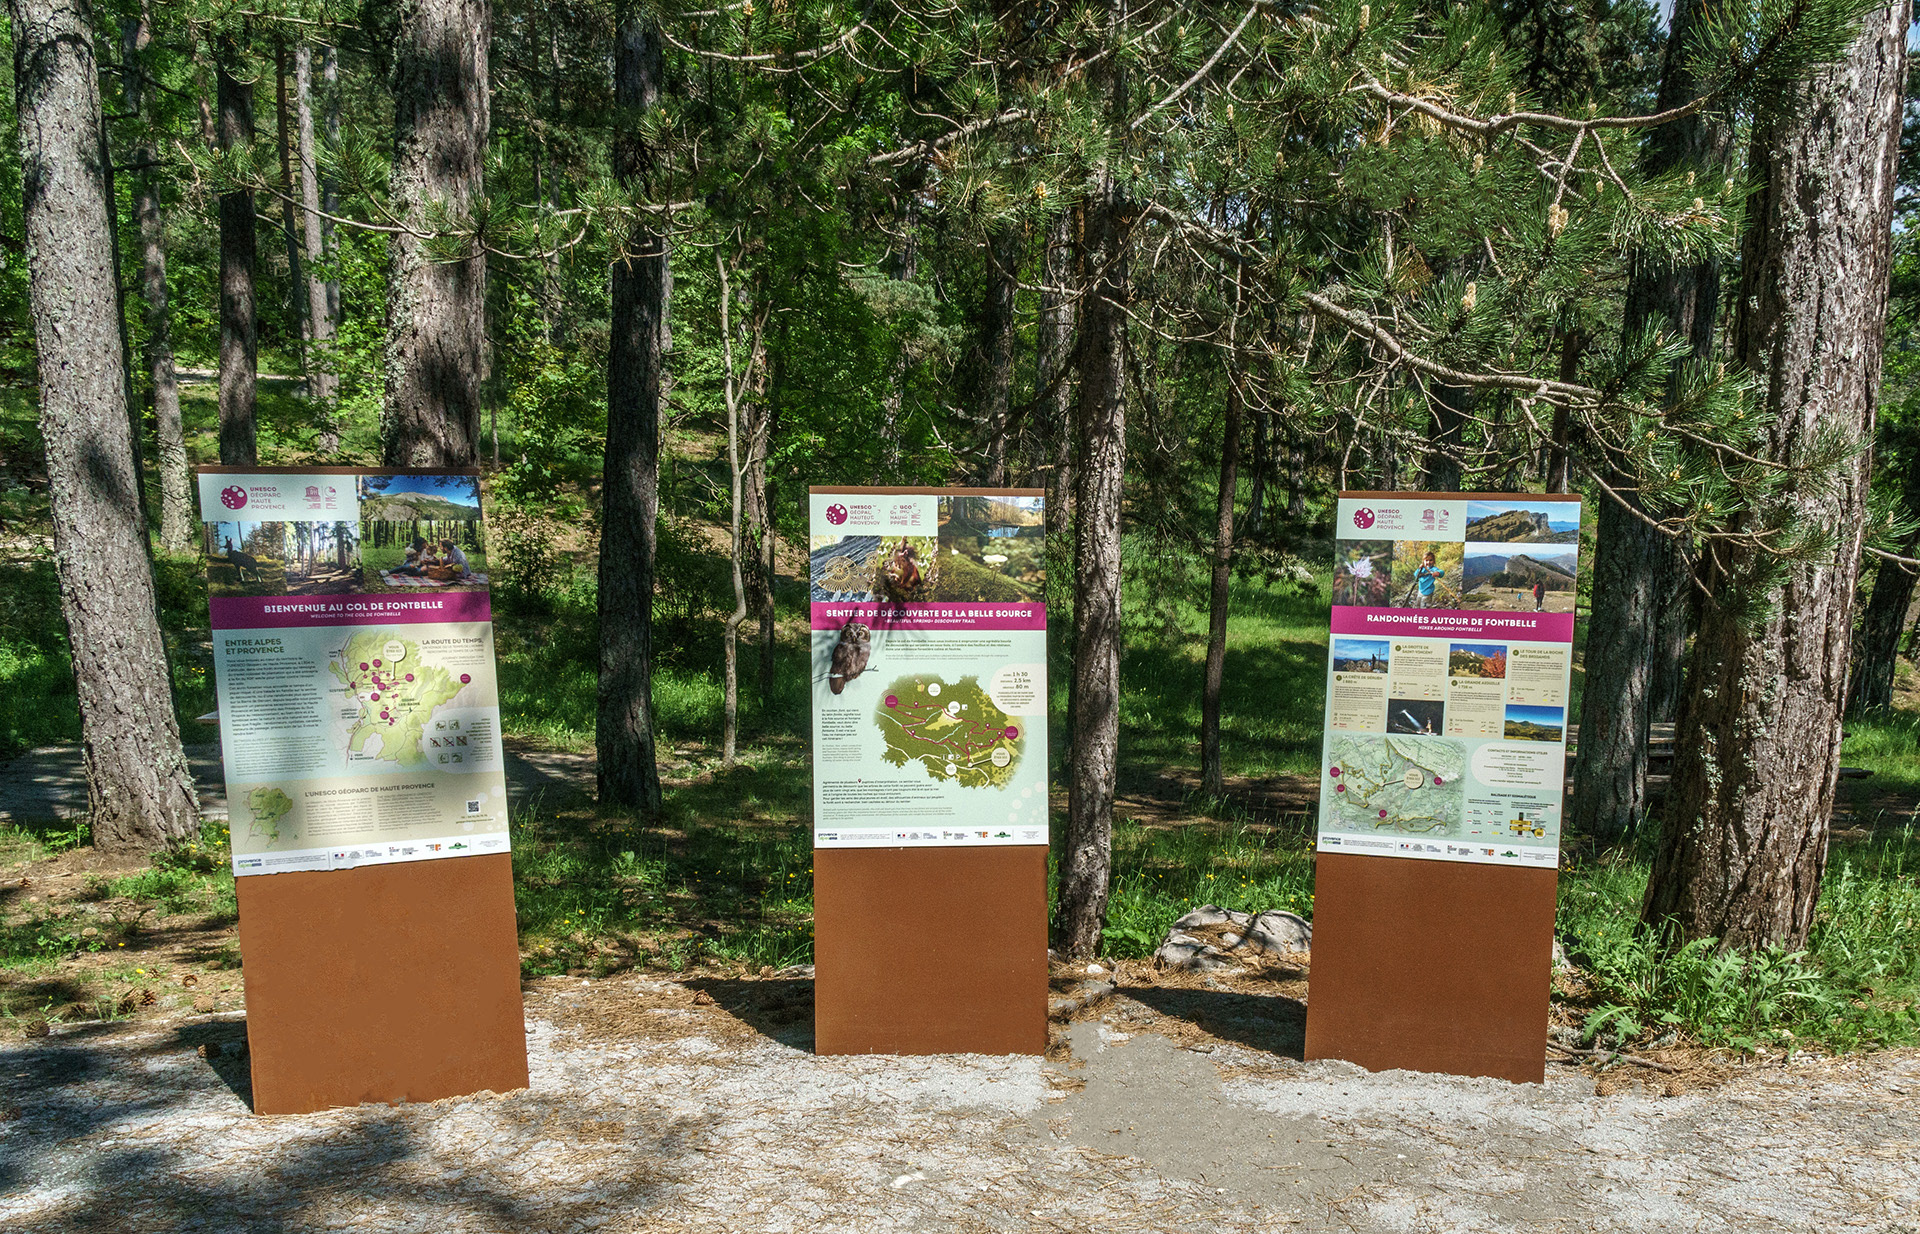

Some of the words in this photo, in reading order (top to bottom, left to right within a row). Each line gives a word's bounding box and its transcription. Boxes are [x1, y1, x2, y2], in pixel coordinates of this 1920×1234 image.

[264, 604, 326, 613] BIENVENUE
[328, 603, 343, 612] AU
[346, 602, 368, 611] COL
[370, 602, 384, 610] DE
[386, 601, 443, 610] FONTBELLE
[881, 608, 939, 617] DÉCOUVERTE
[1367, 614, 1429, 624] RANDONNÉES
[1430, 617, 1468, 625] AUTOUR
[1485, 619, 1536, 627] FONTBELLE
[225, 639, 253, 647] ENTRE
[254, 638, 282, 646] ALPES
[237, 646, 285, 654] PROVENCE
[338, 787, 369, 795] GÉOPARC
